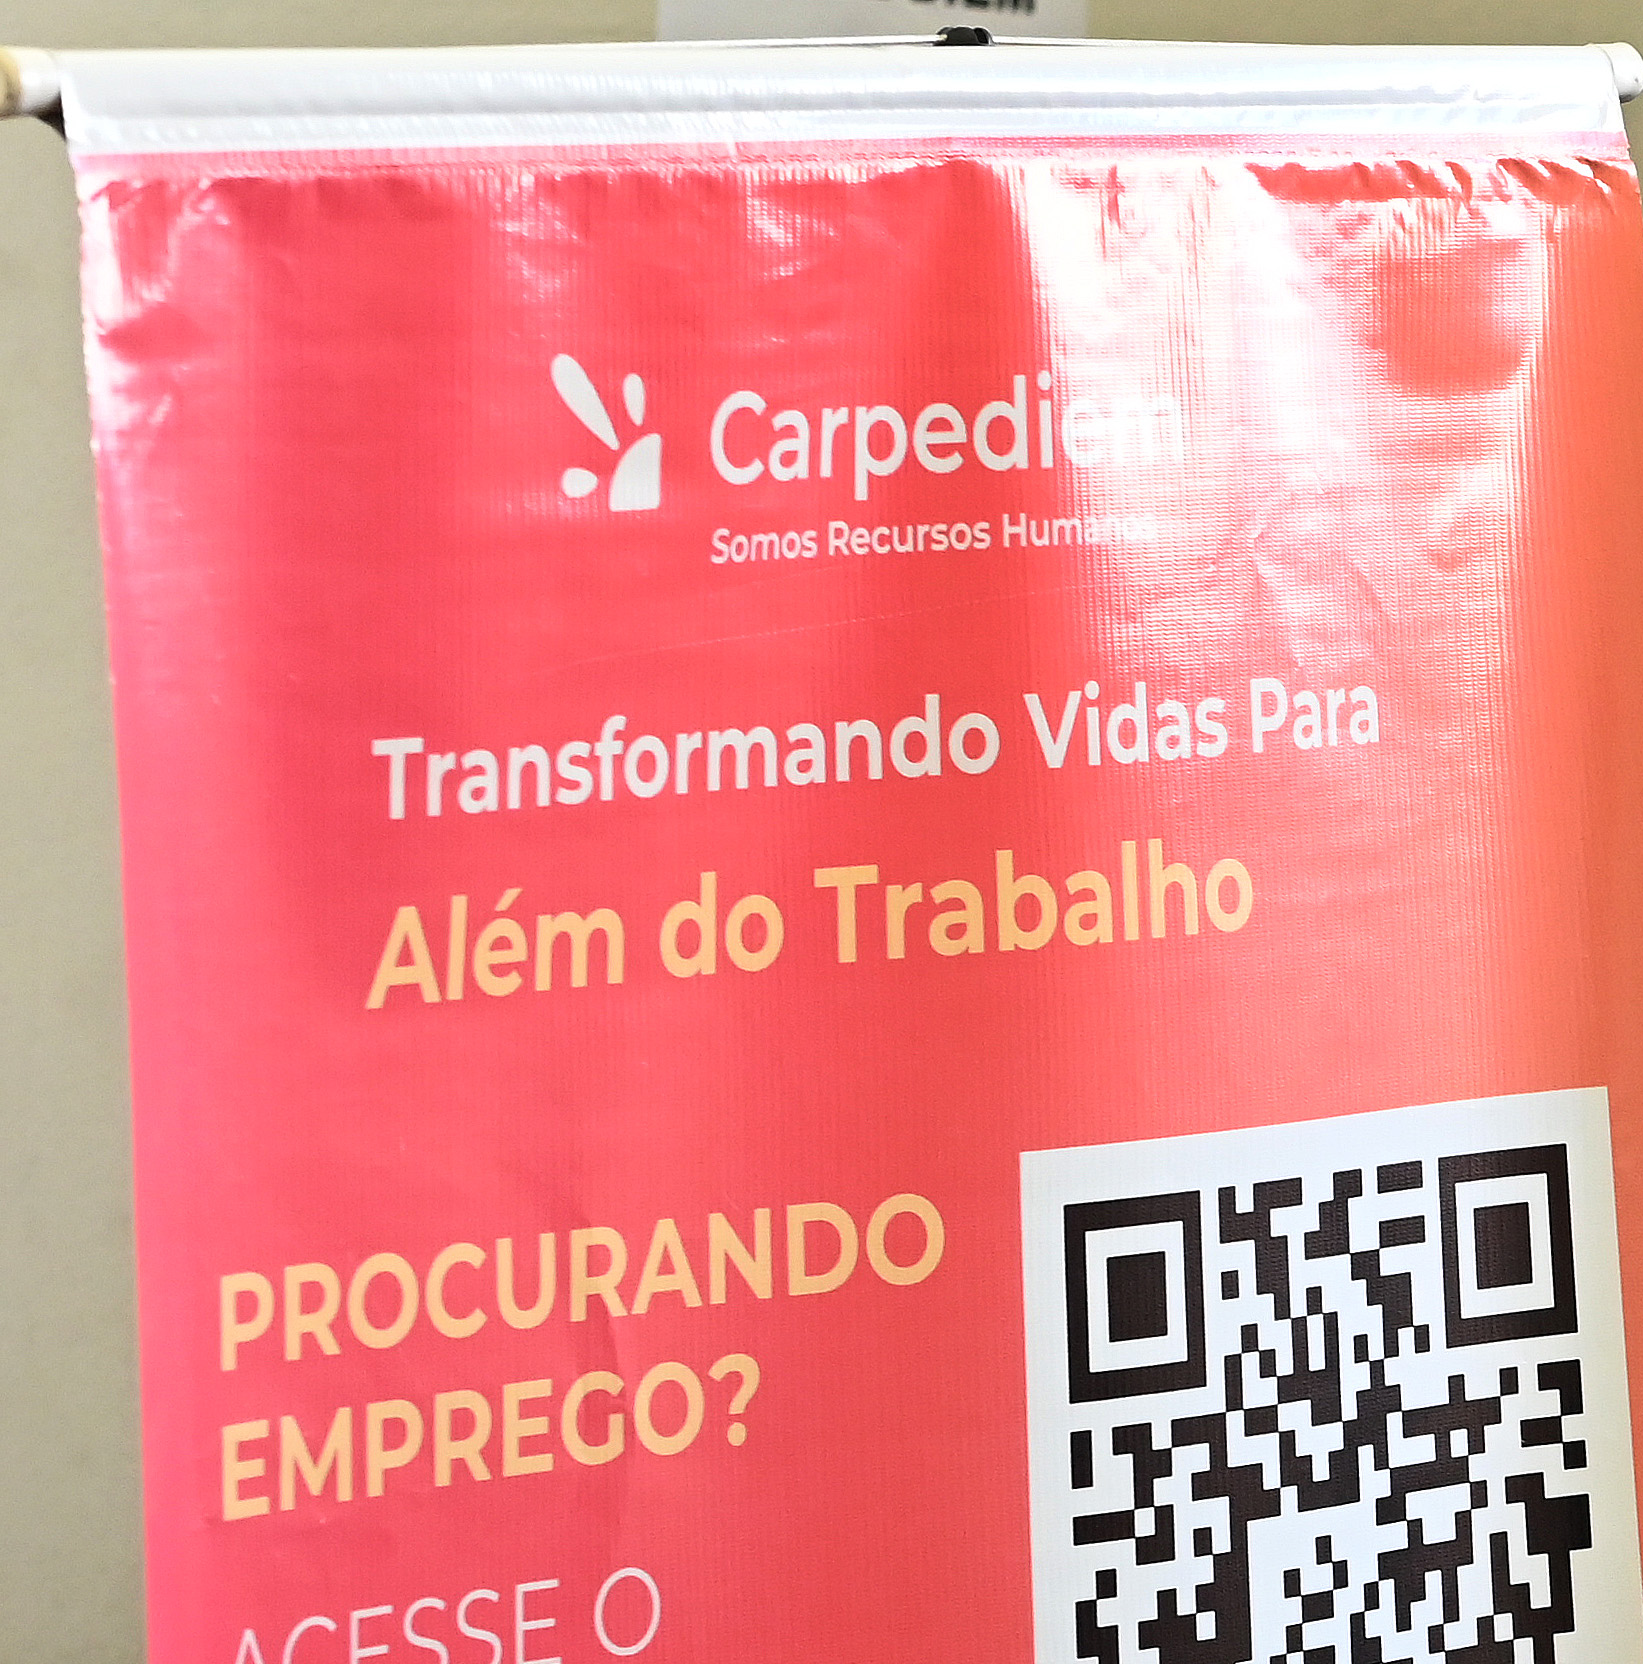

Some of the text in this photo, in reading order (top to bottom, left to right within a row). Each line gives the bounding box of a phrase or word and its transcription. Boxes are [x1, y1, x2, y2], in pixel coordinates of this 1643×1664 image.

[711, 527, 817, 563] Somos
[827, 517, 991, 556] Recursos
[372, 677, 1381, 819] Transformando Vidas Para
[366, 838, 1253, 1009] Além do Trabalho
[220, 1193, 946, 1371] PROCURANDO
[221, 1353, 761, 1521] EMPREGO?
[594, 1567, 661, 1656] O
